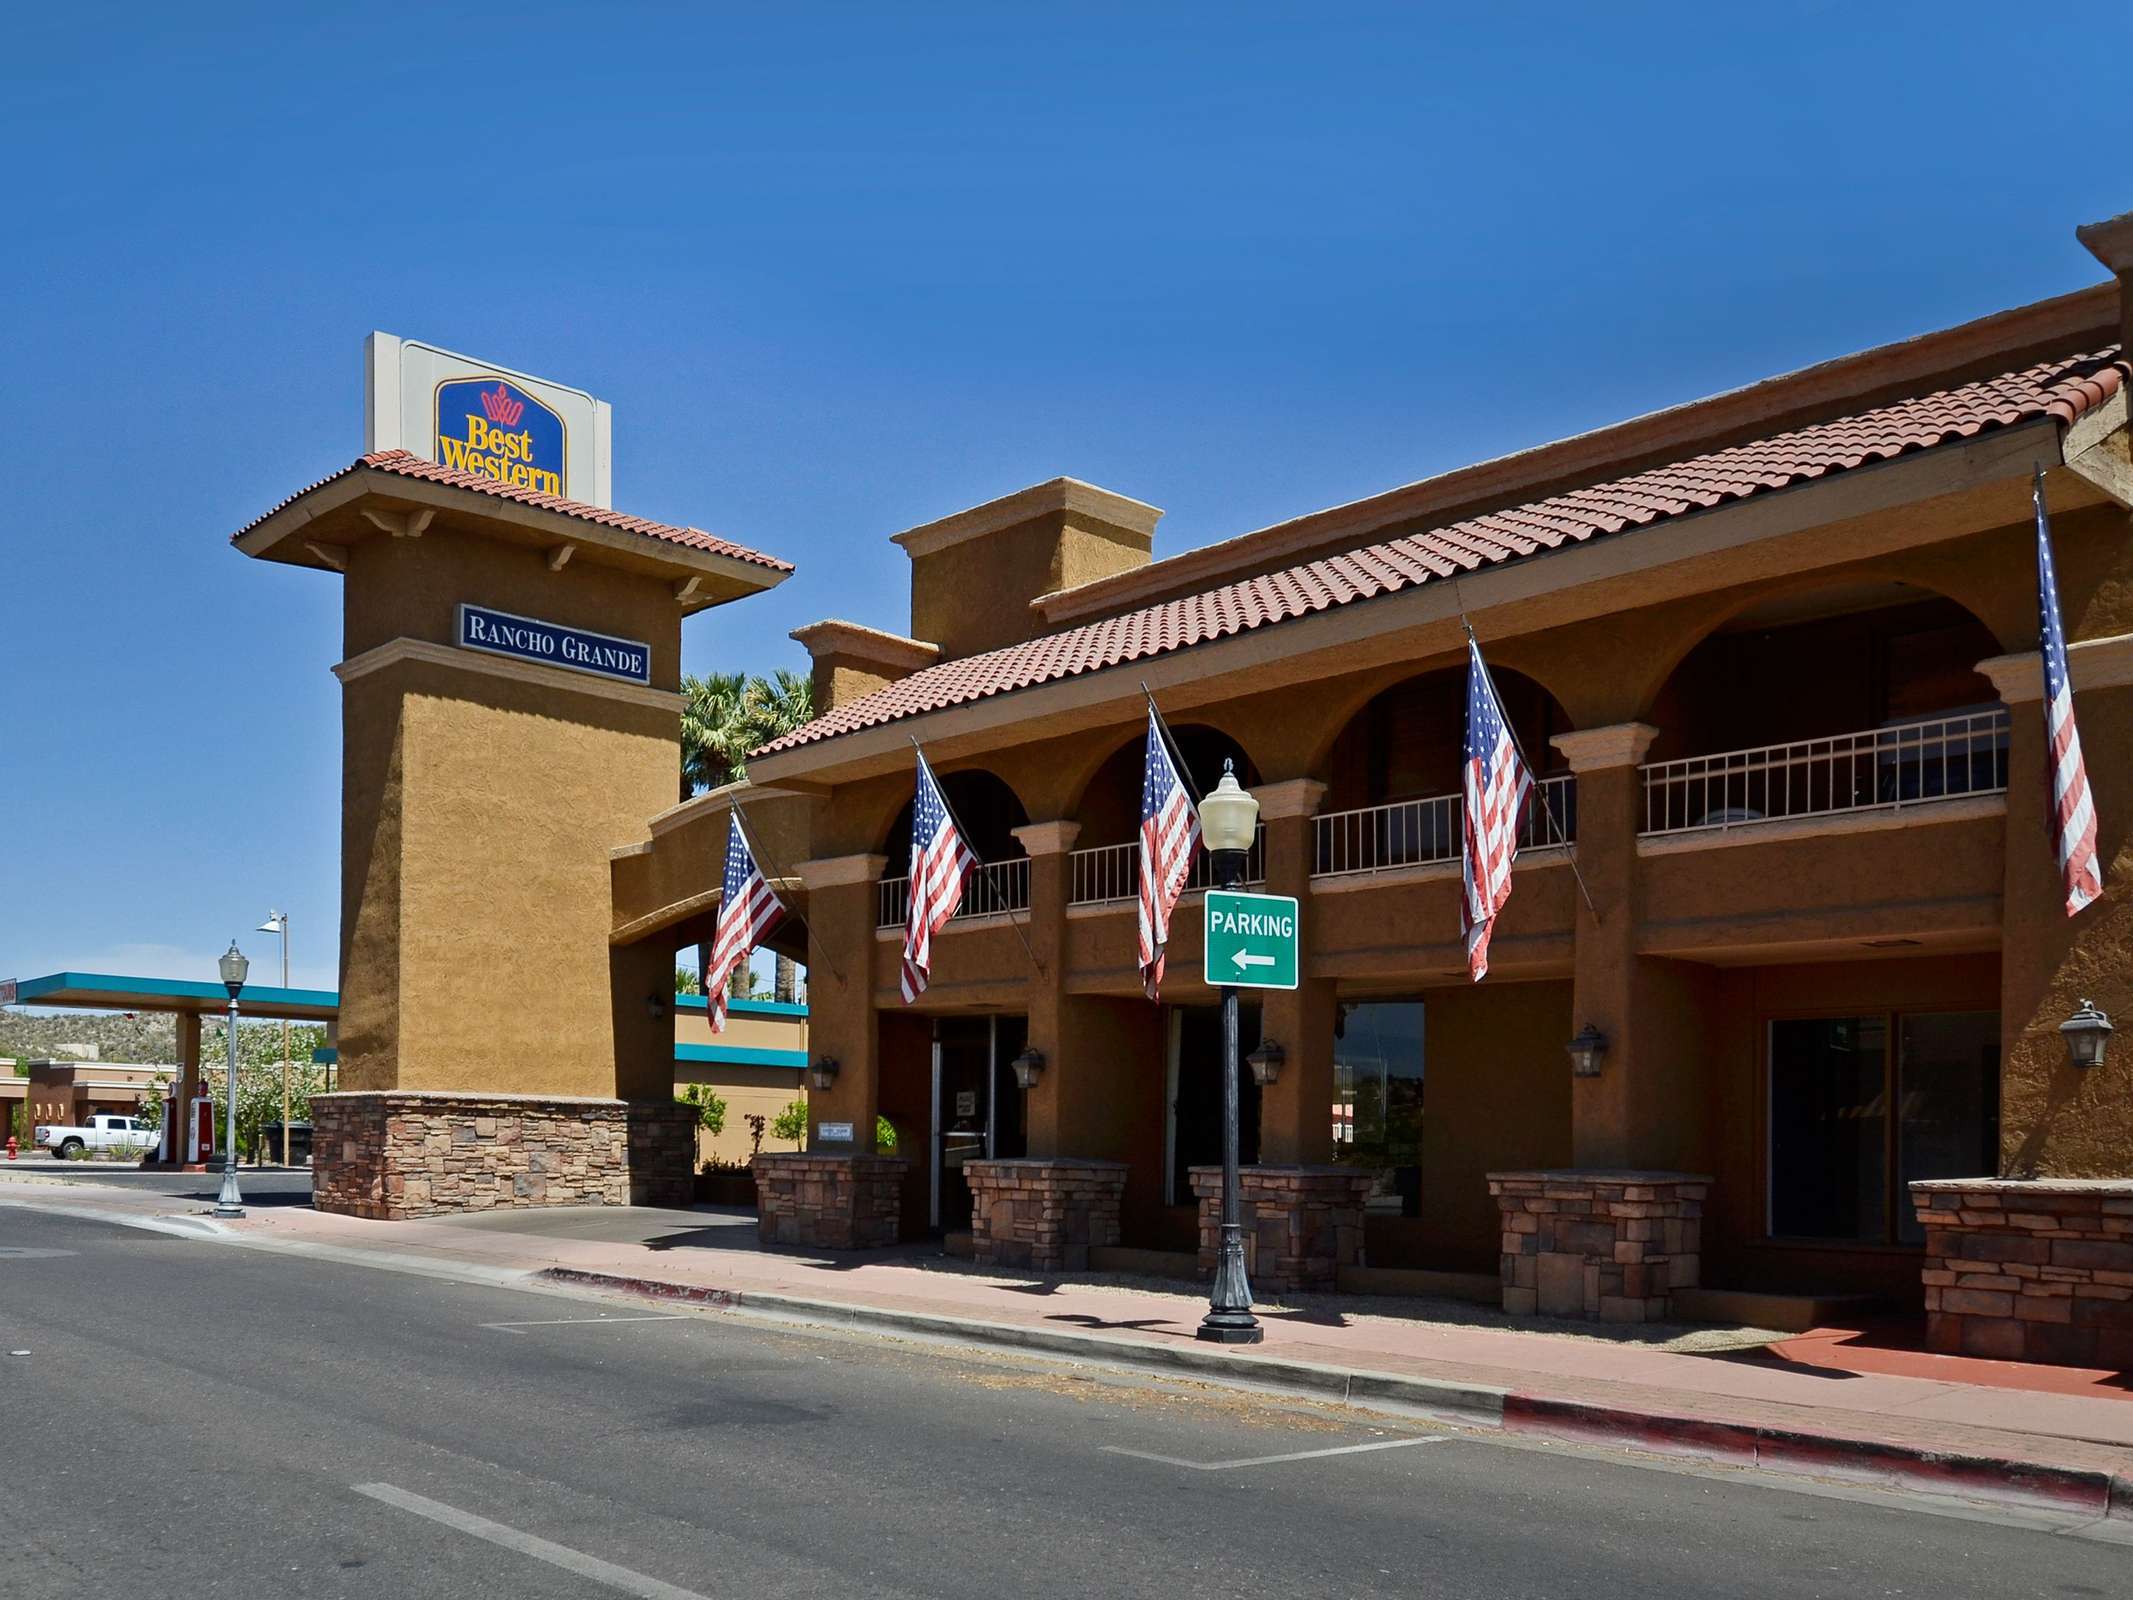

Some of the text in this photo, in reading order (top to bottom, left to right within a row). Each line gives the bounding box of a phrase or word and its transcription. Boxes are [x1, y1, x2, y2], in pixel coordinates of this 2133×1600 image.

[439, 435, 560, 496] Western
[465, 414, 533, 463] Best
[469, 615, 642, 674] RANCHO GRANDE
[1211, 911, 1293, 938] PARKING
